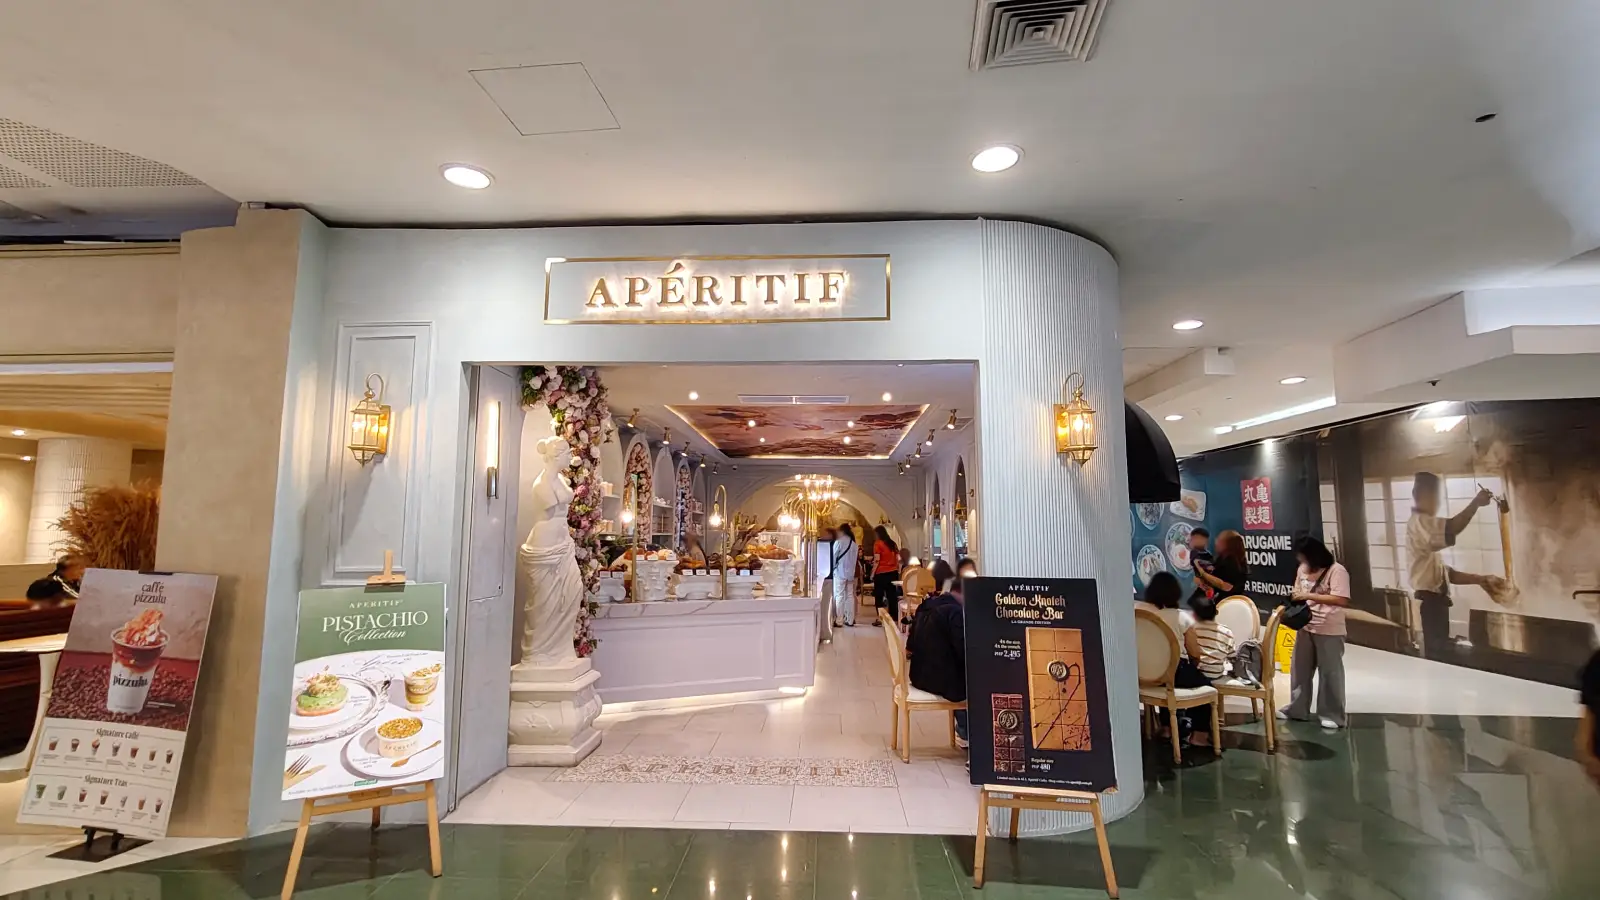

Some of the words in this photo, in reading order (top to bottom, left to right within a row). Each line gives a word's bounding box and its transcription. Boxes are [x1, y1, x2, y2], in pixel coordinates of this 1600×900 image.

[585, 262, 846, 308] APÉRITIF
[1245, 551, 1277, 566] UDON
[133, 592, 167, 605] pizzulu
[995, 592, 1028, 606] Golden
[995, 606, 1040, 620] Chocolate
[1041, 607, 1065, 620] Bar
[322, 610, 429, 632] PISTACHIO
[338, 627, 406, 646] Collection
